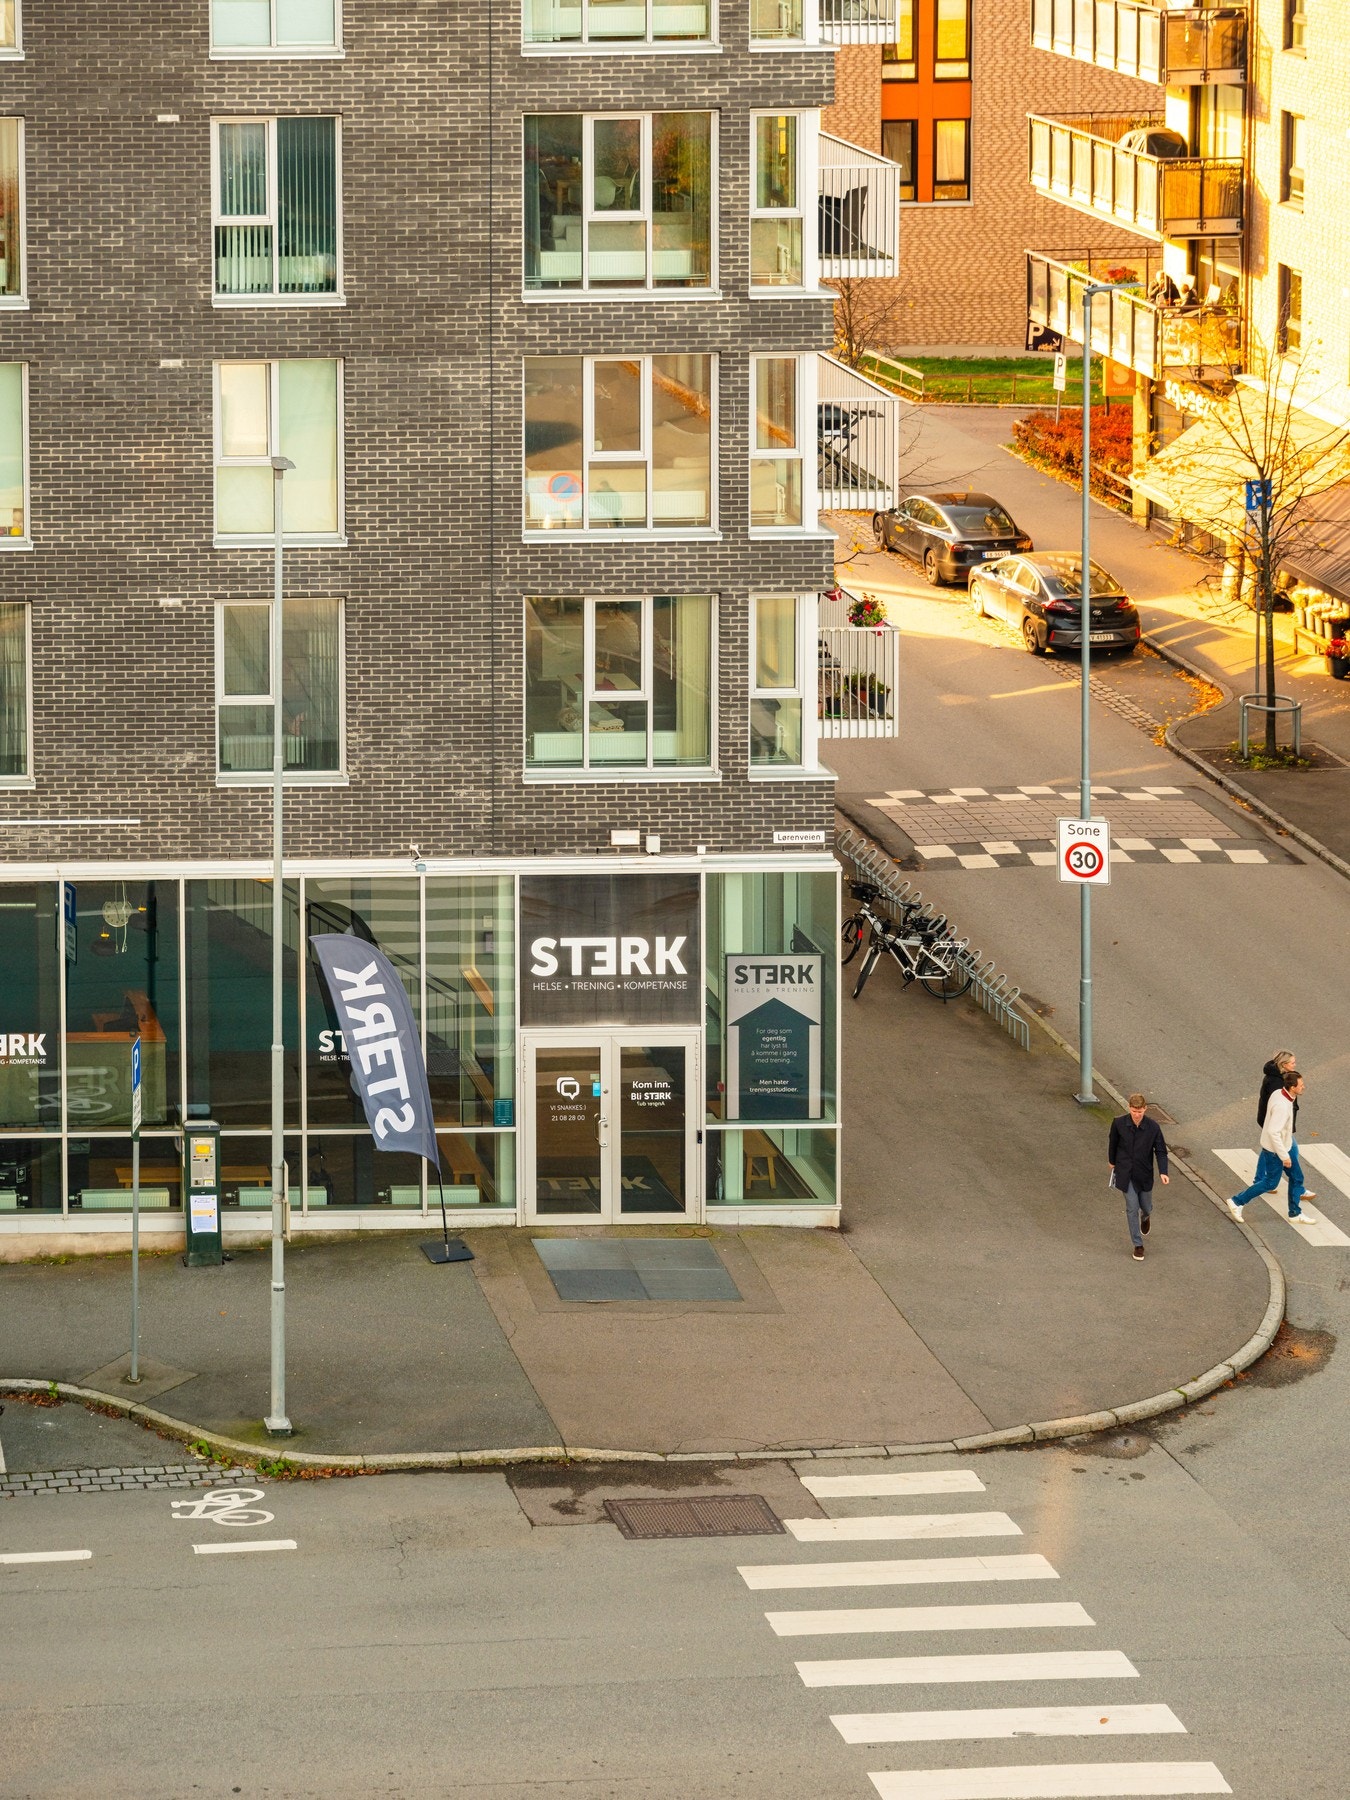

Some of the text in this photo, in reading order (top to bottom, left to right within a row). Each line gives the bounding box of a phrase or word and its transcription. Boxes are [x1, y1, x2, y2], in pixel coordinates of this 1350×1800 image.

[1028, 322, 1044, 344] P
[1056, 356, 1063, 374] P
[1068, 824, 1100, 836] Sone
[1072, 851, 1096, 869] 30
[530, 936, 687, 977] STERK
[734, 965, 814, 984] STERK
[533, 980, 687, 991] HELSE TRENING KOMPETANSE
[134, 1048, 139, 1084] P
